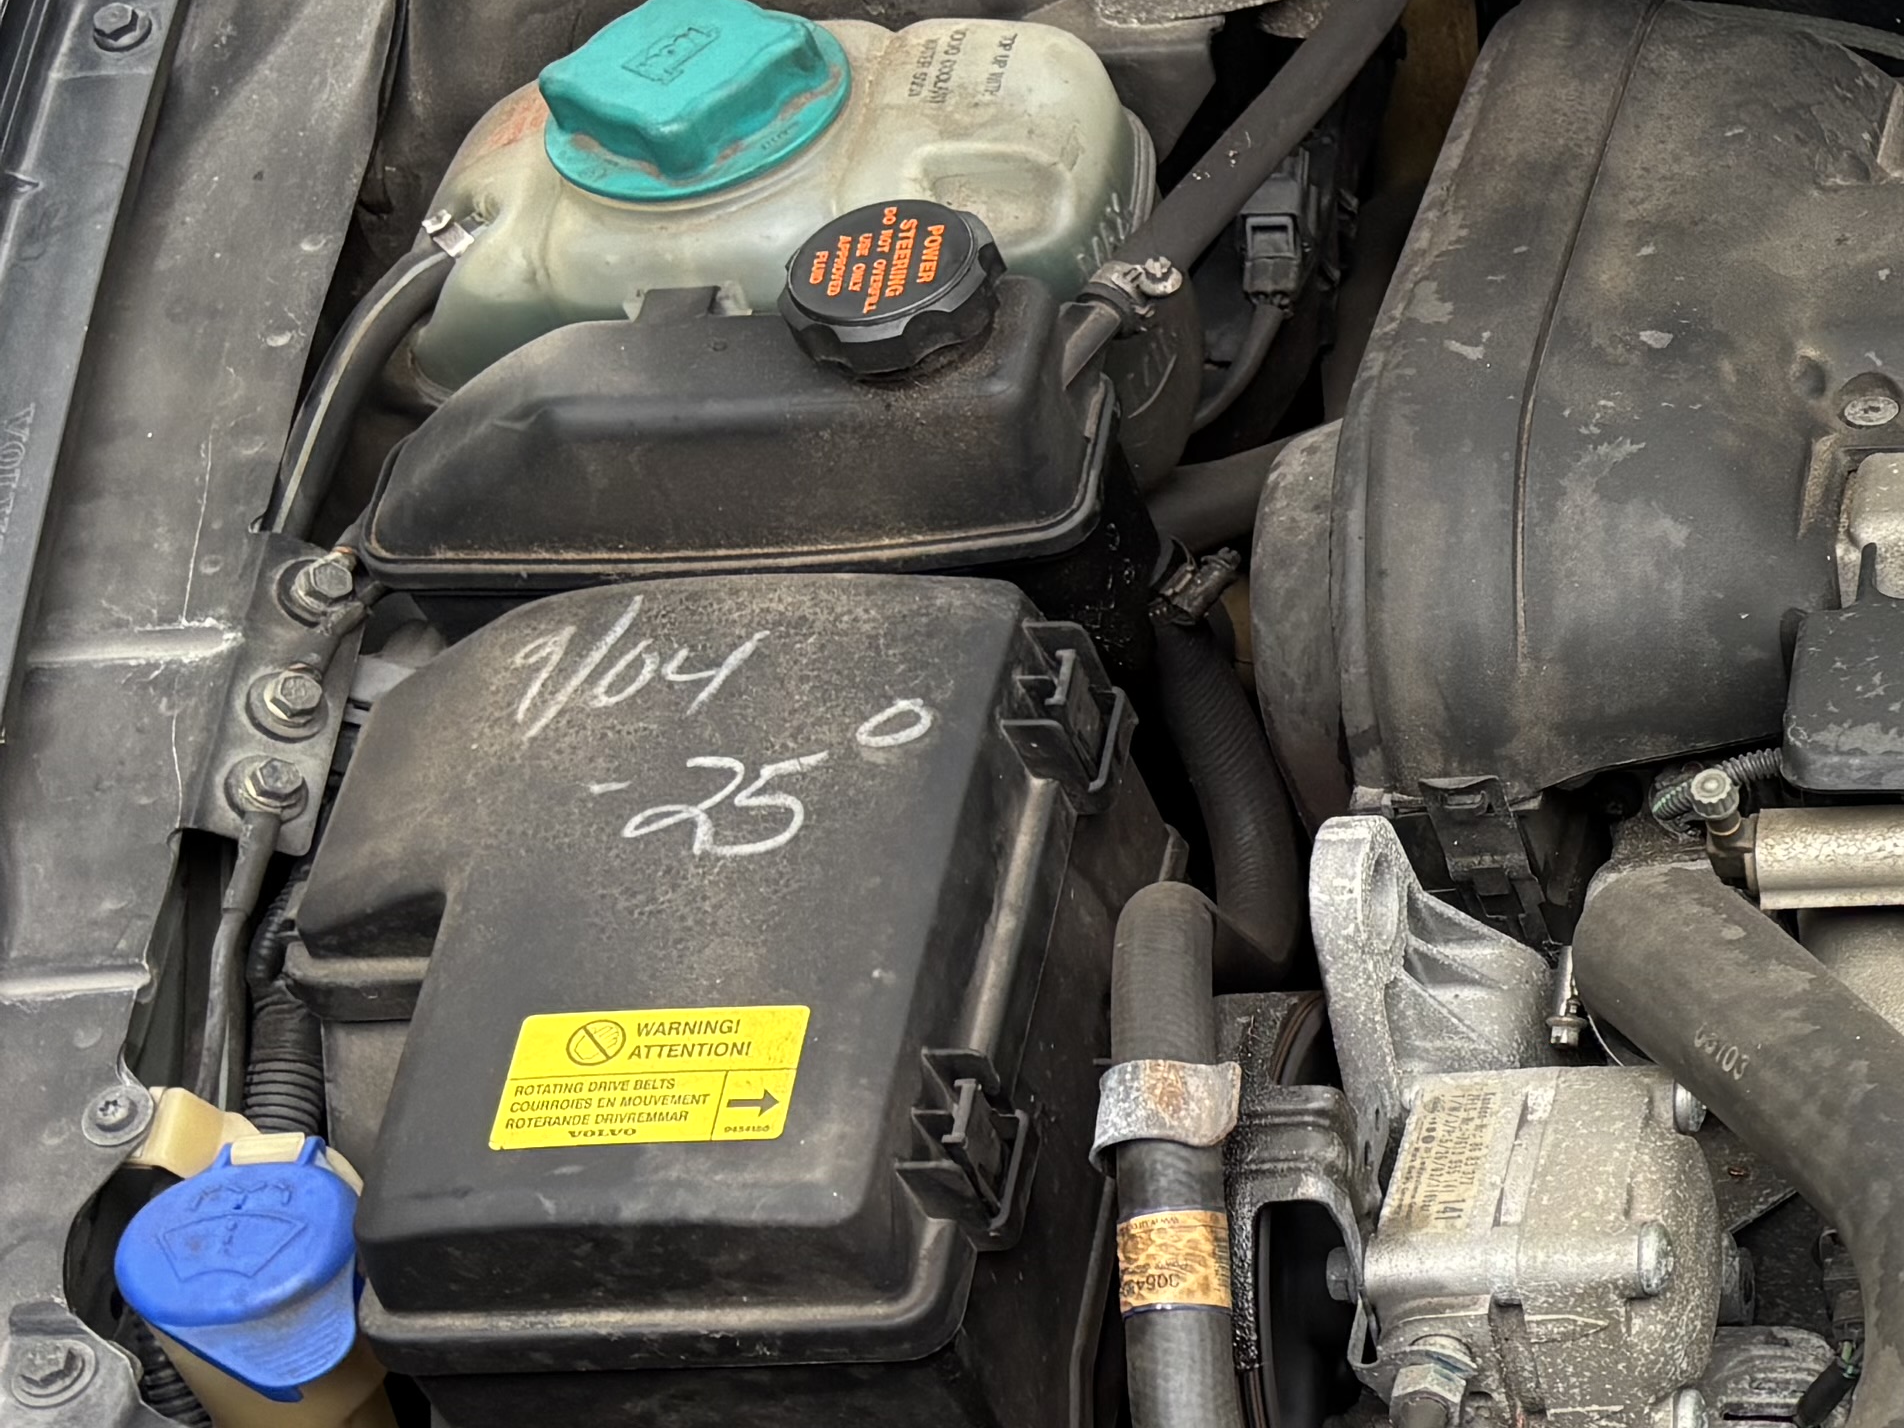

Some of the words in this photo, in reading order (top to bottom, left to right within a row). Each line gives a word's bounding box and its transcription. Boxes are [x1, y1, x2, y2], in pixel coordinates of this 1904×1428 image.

[883, 207, 897, 225] DO
[856, 233, 873, 257] USE
[877, 229, 894, 253] NOT
[885, 219, 918, 297] STEERING
[917, 224, 945, 283] POWER
[810, 251, 829, 284] FLUID
[827, 236, 852, 296] APPROVED
[849, 263, 866, 291] ONLY
[863, 259, 887, 314] OVERFILL
[637, 1019, 740, 1037] WARNING!
[628, 1041, 752, 1060] ATTENTION!
[515, 1083, 583, 1097] ROTATING
[588, 1080, 630, 1093] DRIVE
[634, 1078, 676, 1090] BELTS
[510, 1099, 592, 1113] COURROIES
[597, 1097, 615, 1109] EN
[620, 1093, 710, 1107] MOUVEMENT
[505, 1116, 590, 1130] ROTERANDE
[595, 1110, 689, 1124] DRIVREMMAR
[568, 1128, 637, 1138] VOLVO
[1434, 1198, 1467, 1220] 141
